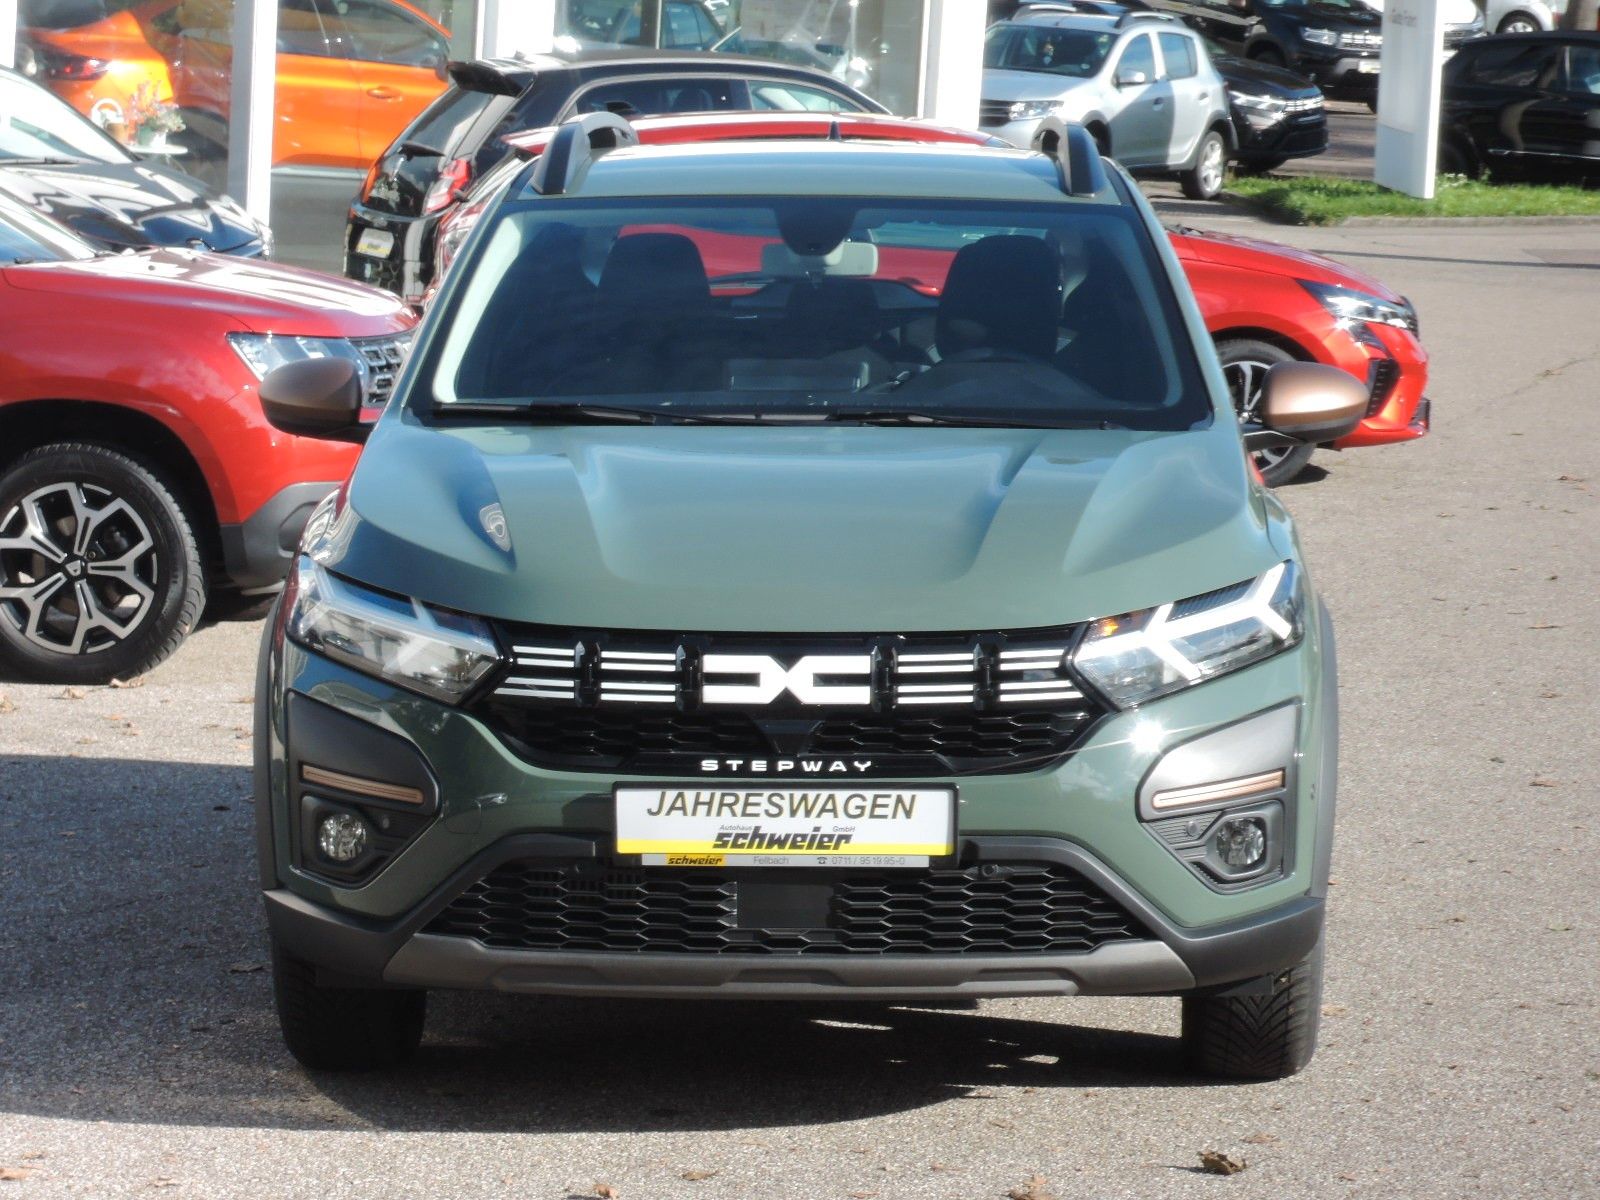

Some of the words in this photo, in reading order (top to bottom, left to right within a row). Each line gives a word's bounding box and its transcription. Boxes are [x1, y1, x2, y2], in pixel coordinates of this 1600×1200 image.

[701, 759, 872, 772] STEPWAY
[647, 790, 917, 820] JAHRESWAGEN
[712, 826, 853, 850] schweier
[667, 856, 723, 865] schweier
[753, 856, 789, 865] Fellbach
